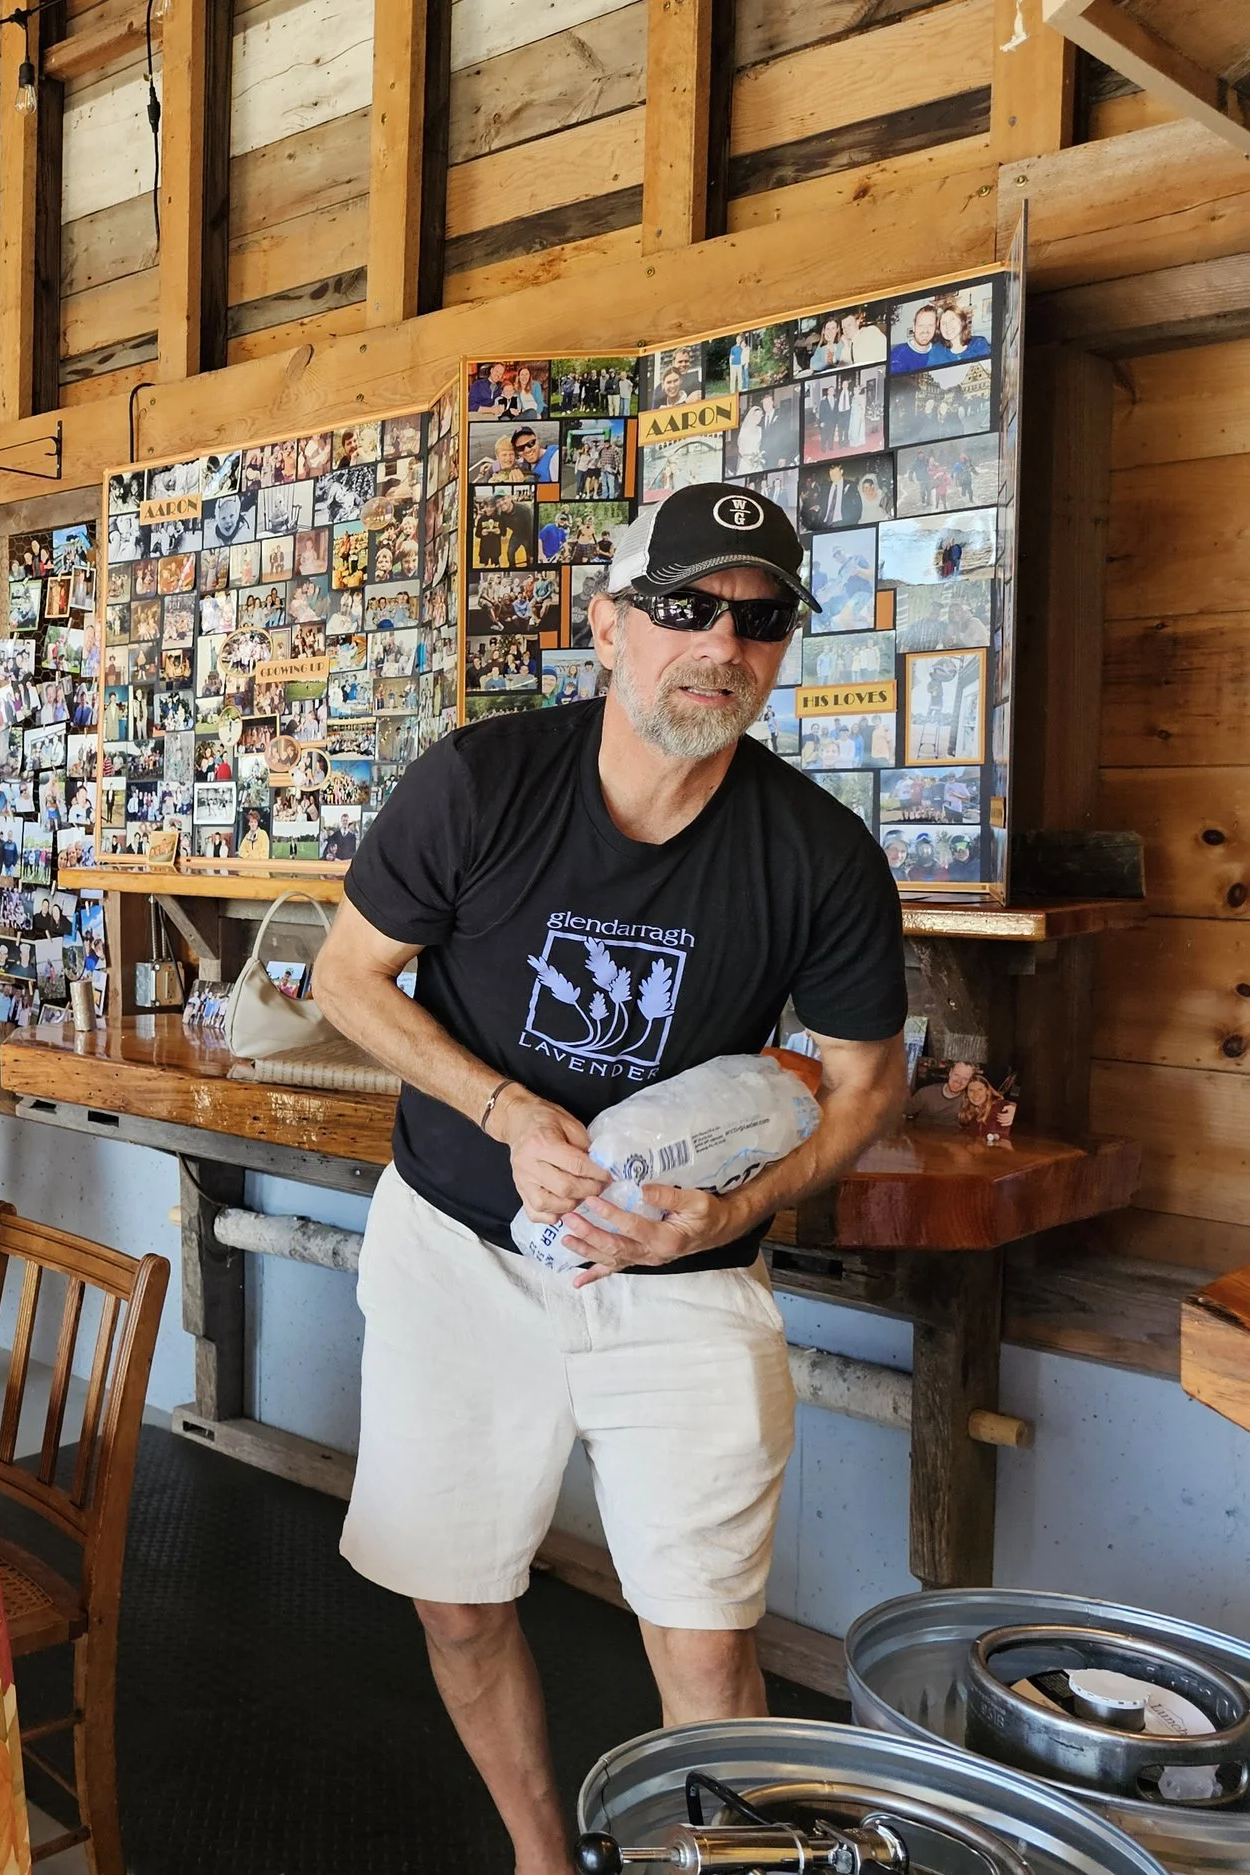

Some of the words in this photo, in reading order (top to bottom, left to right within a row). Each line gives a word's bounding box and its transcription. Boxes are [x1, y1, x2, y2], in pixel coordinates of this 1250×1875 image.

[645, 402, 732, 438] AARON
[144, 498, 198, 518] AARON
[732, 499, 747, 510] W
[734, 512, 746, 525] G
[260, 663, 308, 677] GROWING
[309, 662, 324, 672] UP
[803, 694, 829, 708] HIS
[833, 690, 888, 706] LOVES
[546, 911, 696, 948] glendarragh
[518, 1032, 660, 1082] LAVENDER
